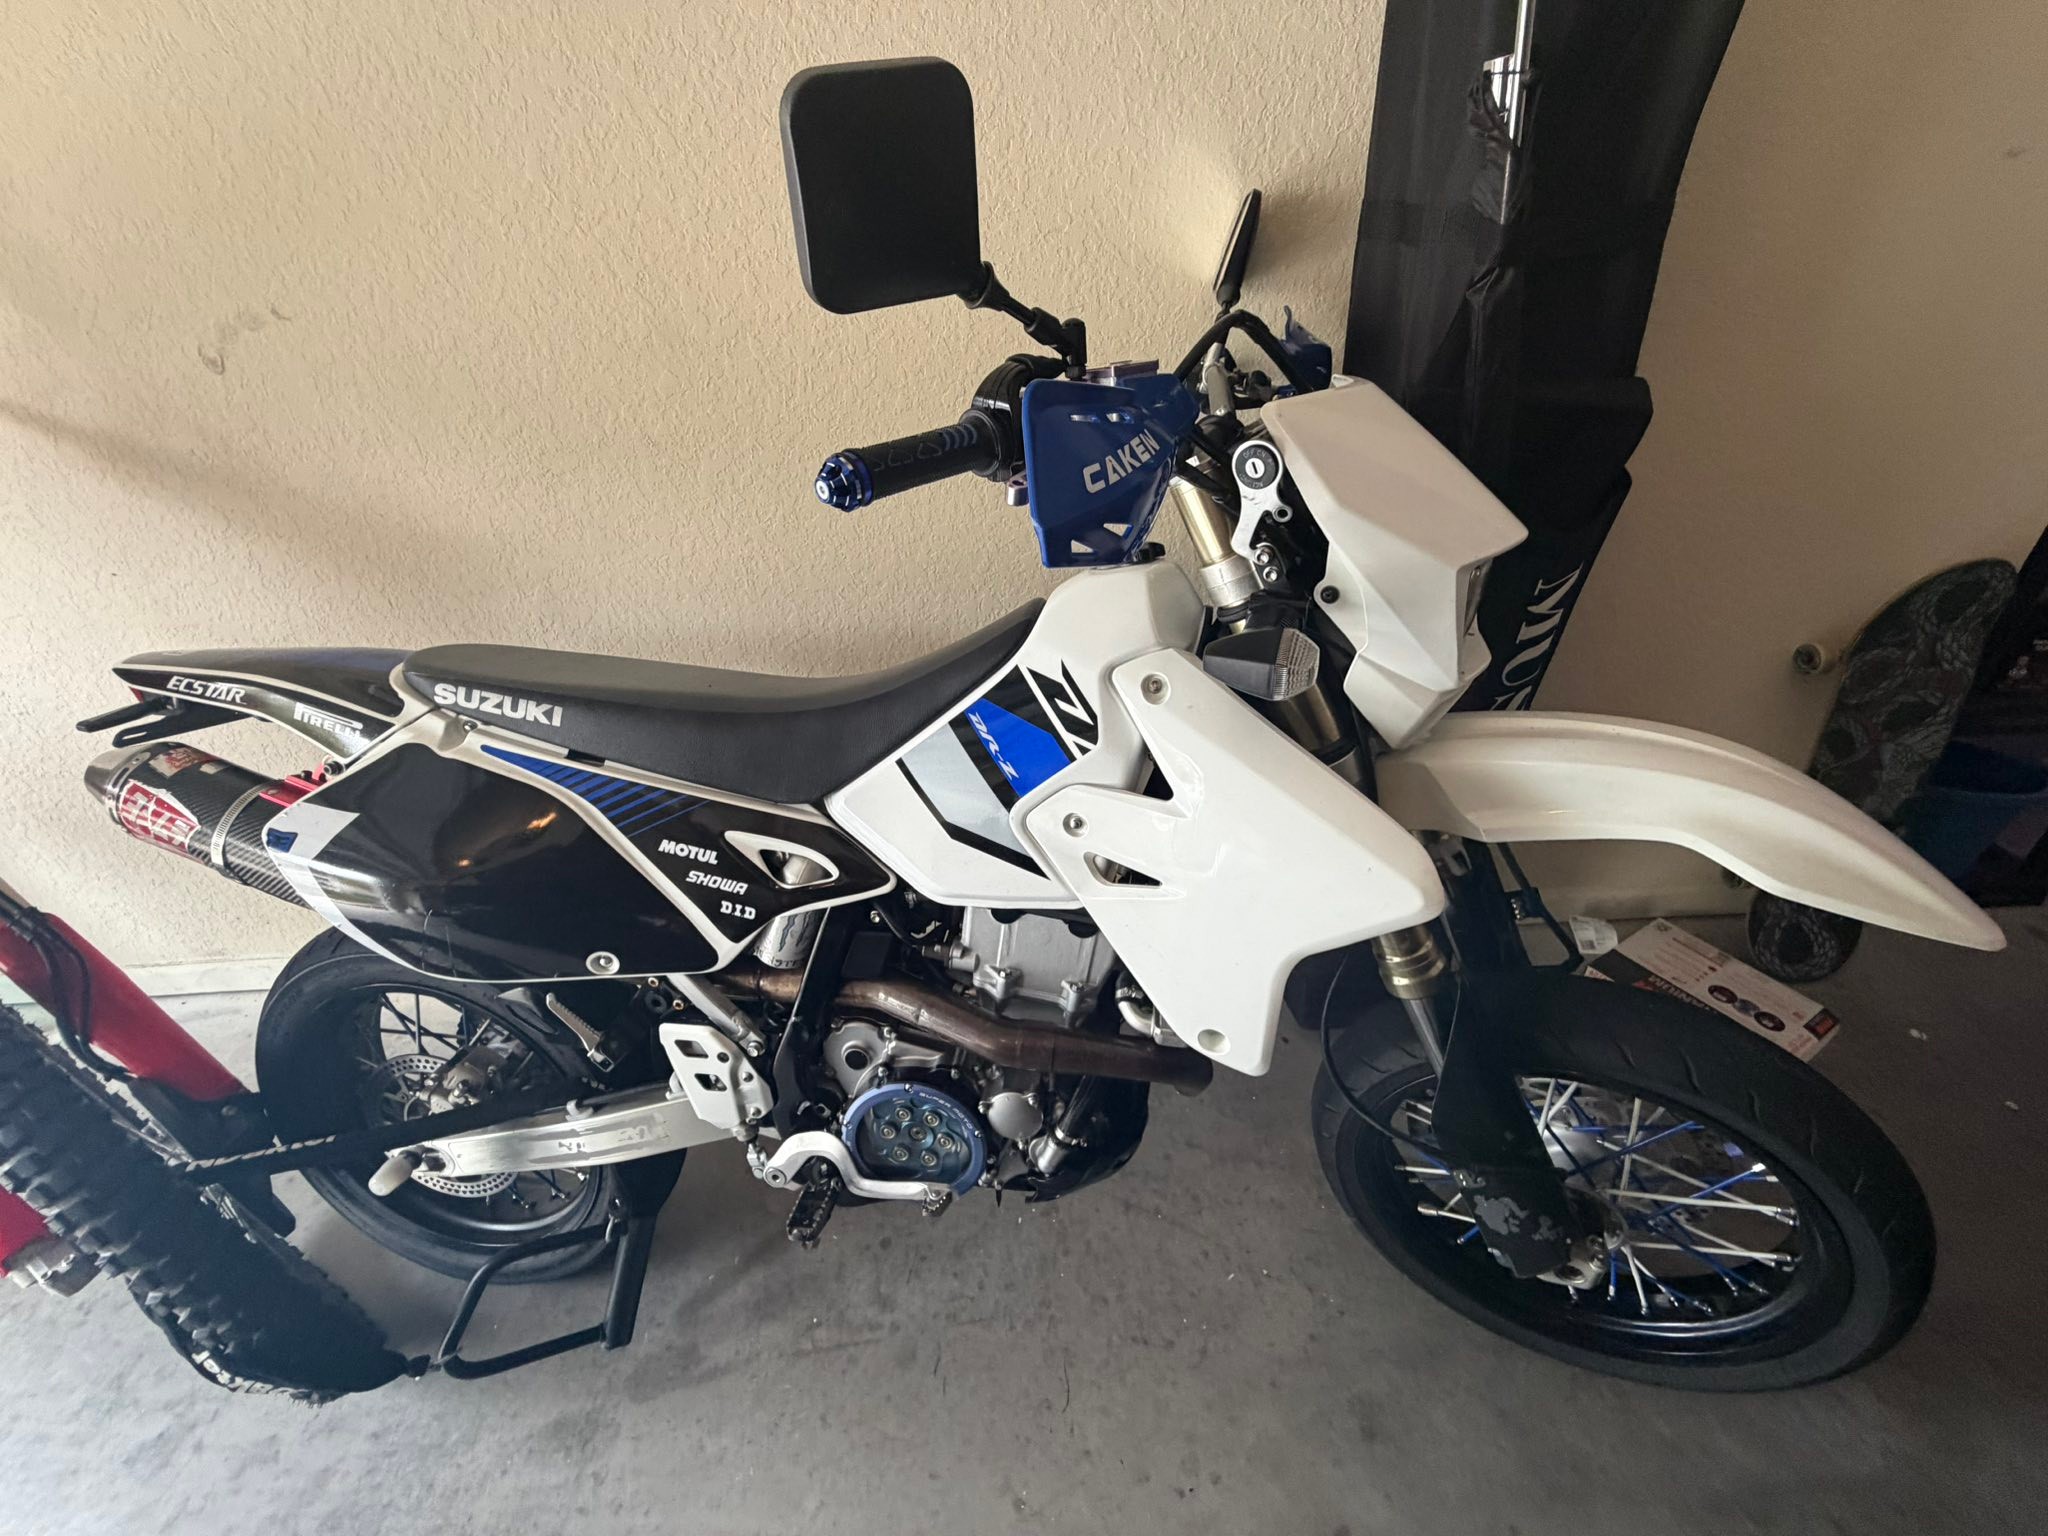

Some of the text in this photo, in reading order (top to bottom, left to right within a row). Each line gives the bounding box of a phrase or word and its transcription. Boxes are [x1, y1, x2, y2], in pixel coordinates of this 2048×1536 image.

[1083, 429, 1160, 494] CAKEN
[166, 675, 247, 705] ECSTAR
[433, 683, 563, 727] SUZUKI
[293, 701, 364, 739] PIRELLI
[967, 711, 1020, 781] DR-Z
[658, 839, 718, 866] MOTUL
[686, 870, 749, 896] SHOWA
